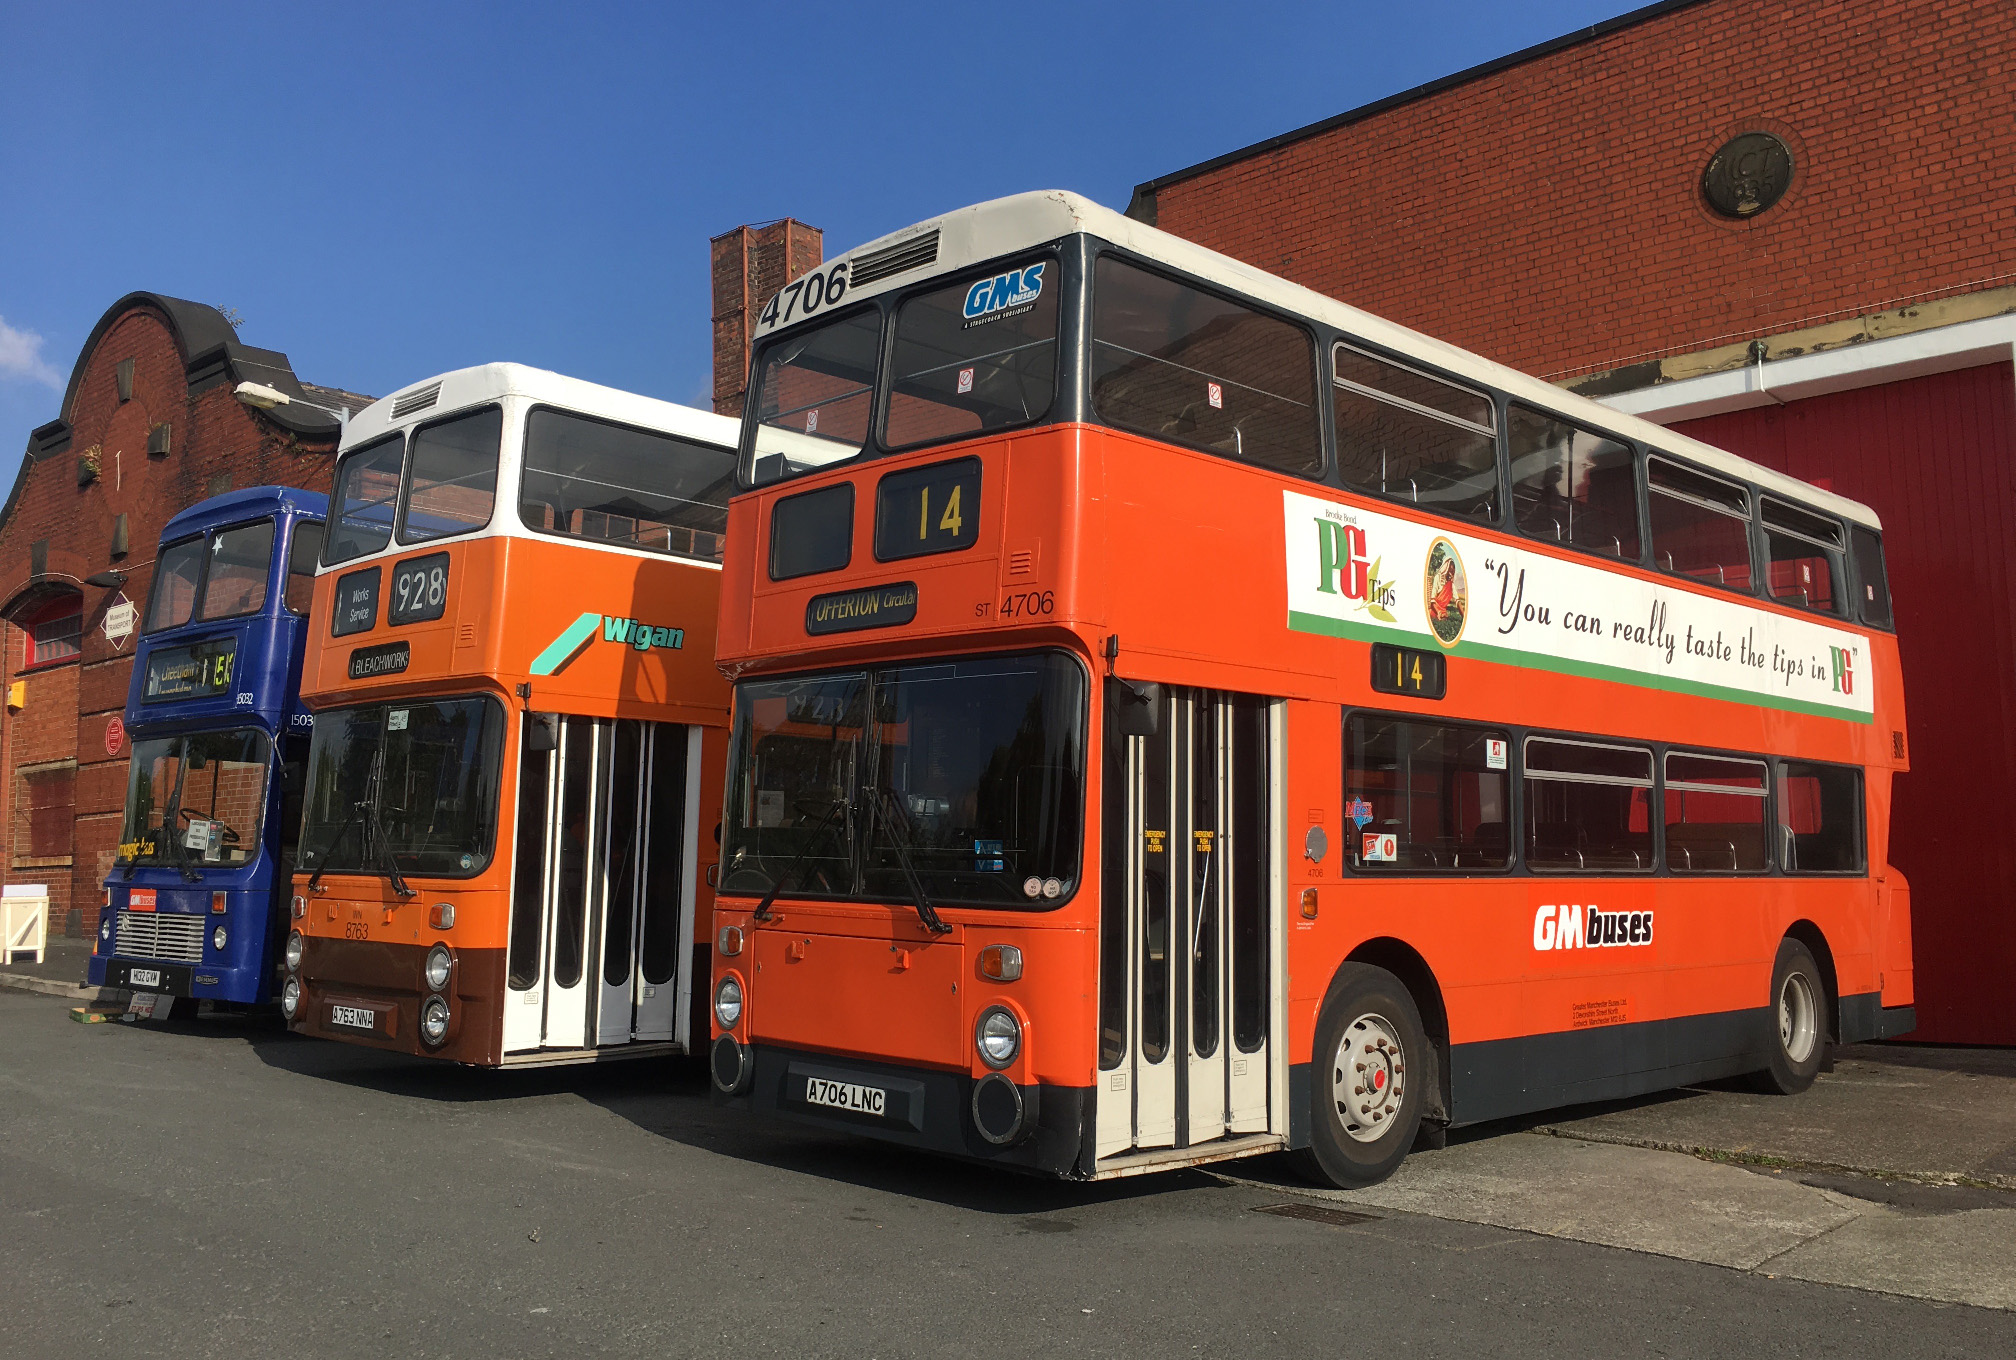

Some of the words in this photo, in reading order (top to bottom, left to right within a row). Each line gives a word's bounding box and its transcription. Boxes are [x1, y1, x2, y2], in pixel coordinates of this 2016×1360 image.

[761, 263, 847, 328] 4706
[963, 262, 1046, 319] GMS
[1012, 289, 1037, 303] buses
[920, 485, 962, 540] 14
[1325, 509, 1342, 521] Brooke
[1343, 514, 1357, 524] Bond
[1314, 517, 1370, 602] PG
[352, 588, 369, 603] Works
[975, 603, 991, 617] ST
[1000, 590, 1054, 617] 4706
[1368, 578, 1396, 611] Tips
[107, 619, 131, 631] TRANSPORT
[349, 608, 369, 622] Service
[603, 615, 684, 651] Wigan
[1563, 611, 1602, 636] can
[1613, 599, 1675, 665] really
[1686, 625, 1731, 662] taste
[1740, 626, 1765, 669] the
[1773, 643, 1804, 687] tips
[1811, 656, 1826, 681] in
[1397, 652, 1423, 690] 14
[119, 837, 139, 861] magic
[1307, 868, 1323, 878] 4706
[345, 922, 368, 940] 8763
[1533, 904, 1583, 951] GM
[1585, 904, 1653, 948] buses
[332, 1007, 354, 1024] A763
[355, 1010, 373, 1027] NNA
[808, 1080, 847, 1105] A706
[851, 1086, 882, 1111] LNC
